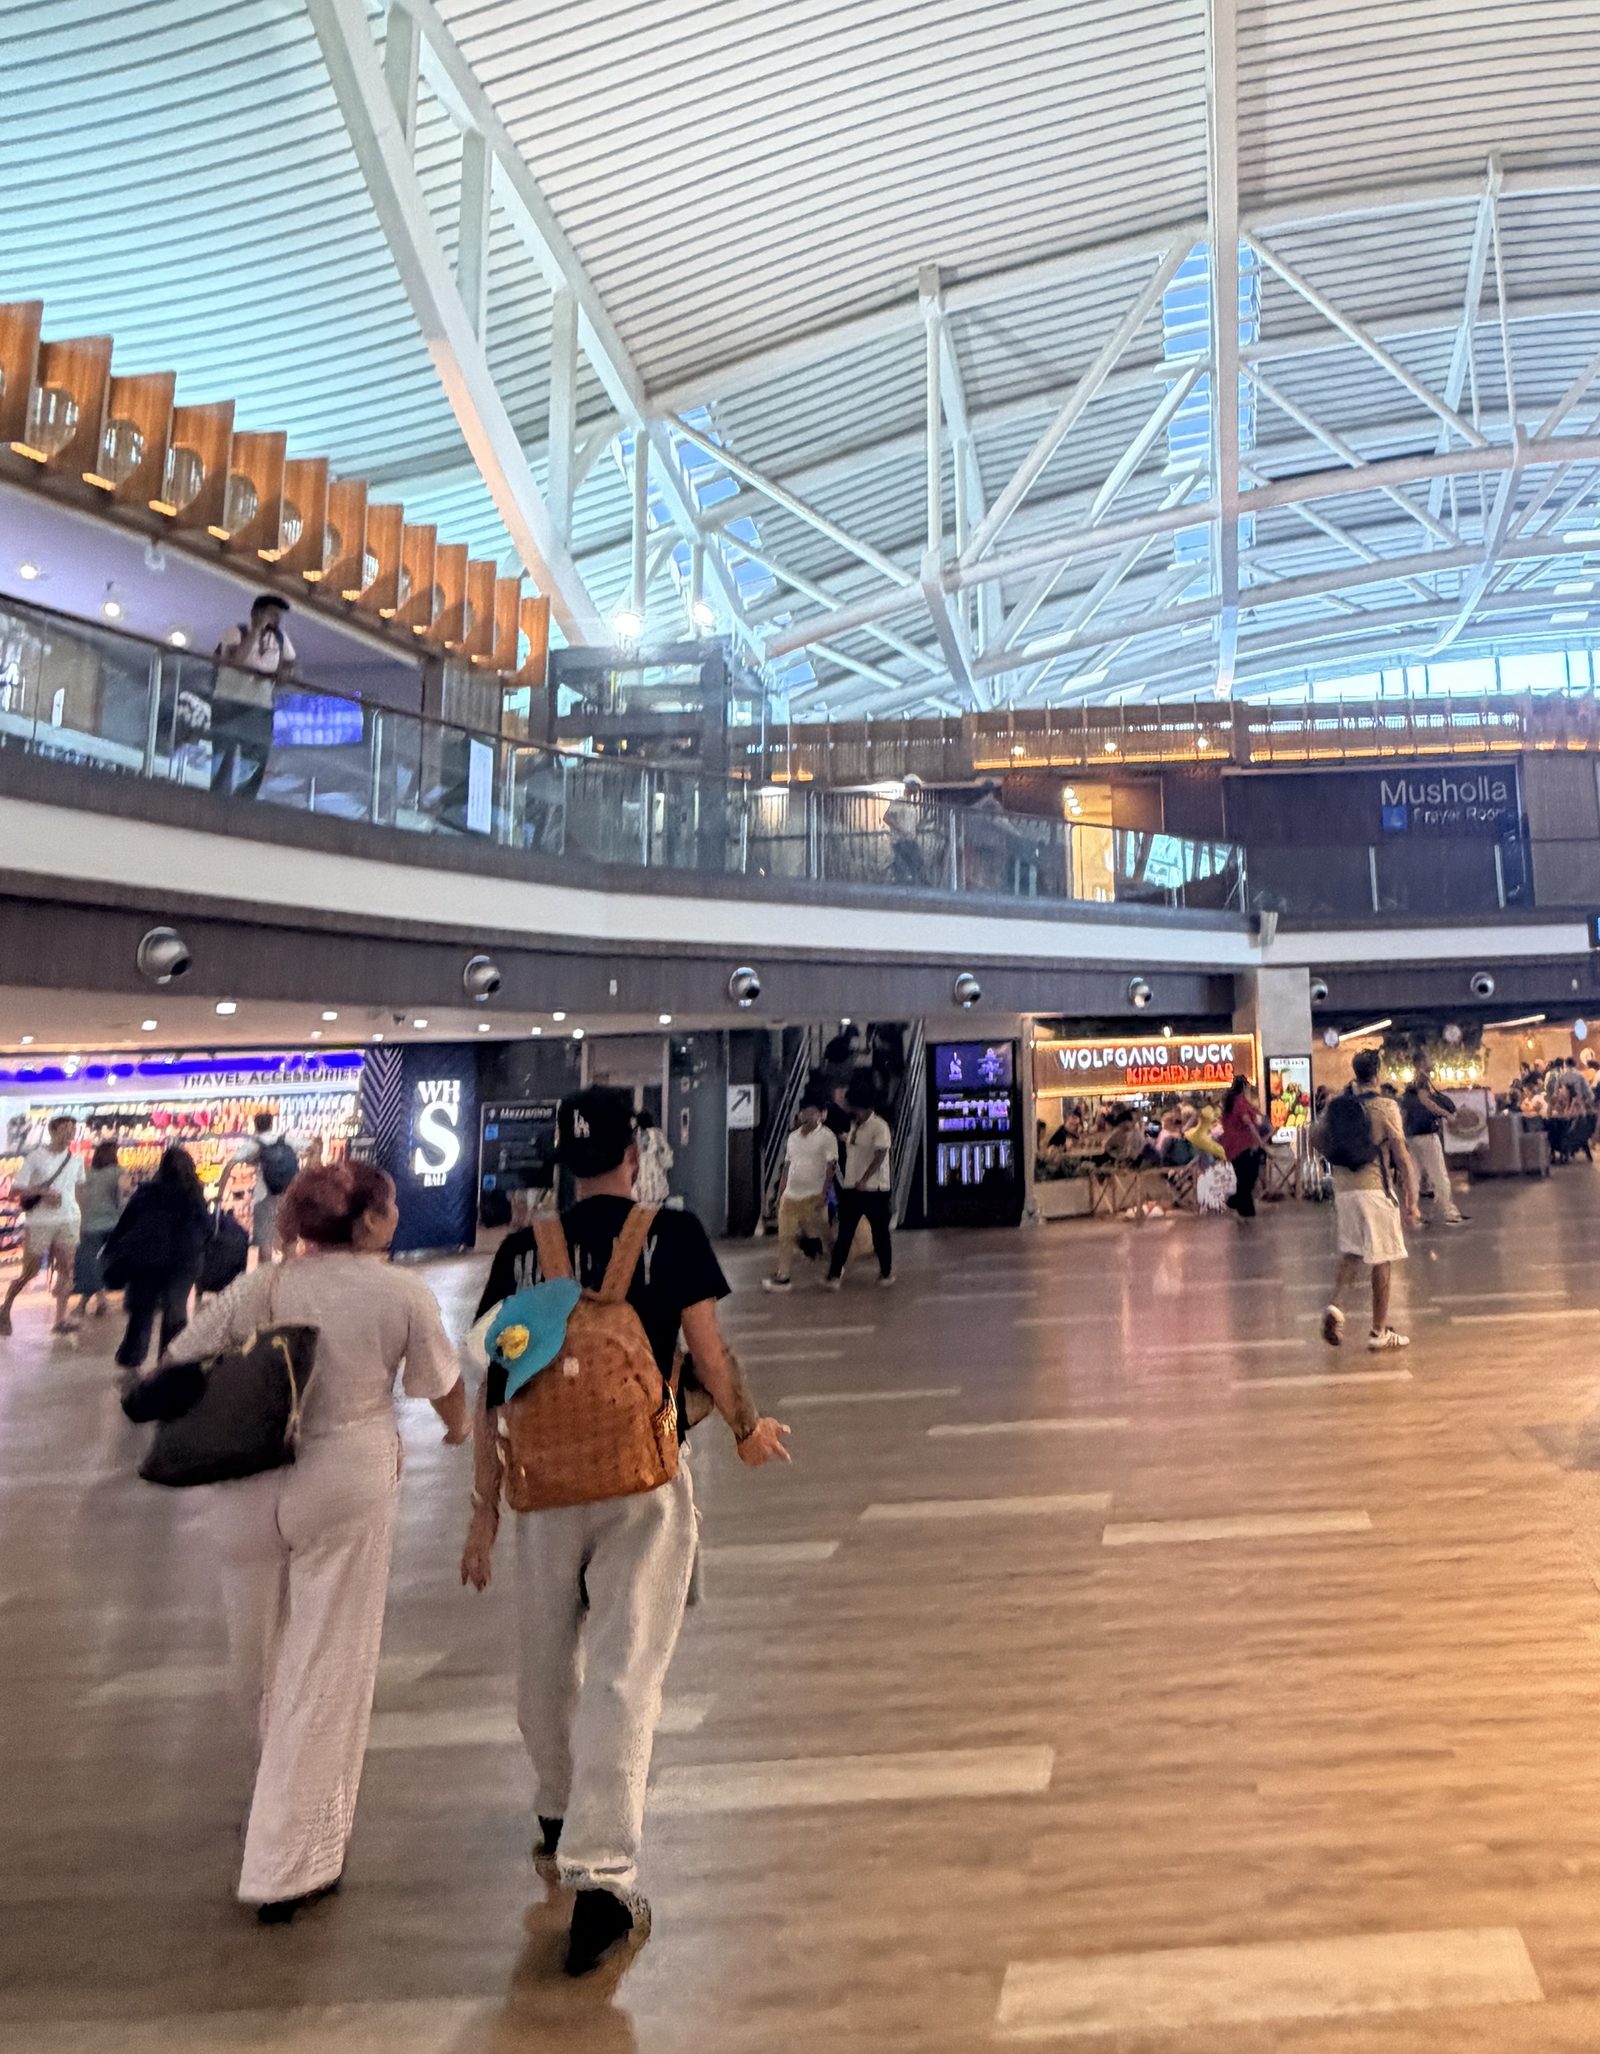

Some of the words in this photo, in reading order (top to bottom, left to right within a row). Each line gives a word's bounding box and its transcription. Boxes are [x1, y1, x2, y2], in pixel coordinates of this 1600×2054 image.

[1380, 776, 1508, 806] Musholla
[1059, 1046, 1168, 1071] WOLFGANG
[1180, 1043, 1234, 1064] PUCK
[182, 1072, 245, 1089] TRAVEL
[249, 1067, 359, 1085] ACCESSORIES
[1126, 1065, 1189, 1086] KITCHEN
[418, 1080, 461, 1103] WH
[414, 1100, 460, 1175] S
